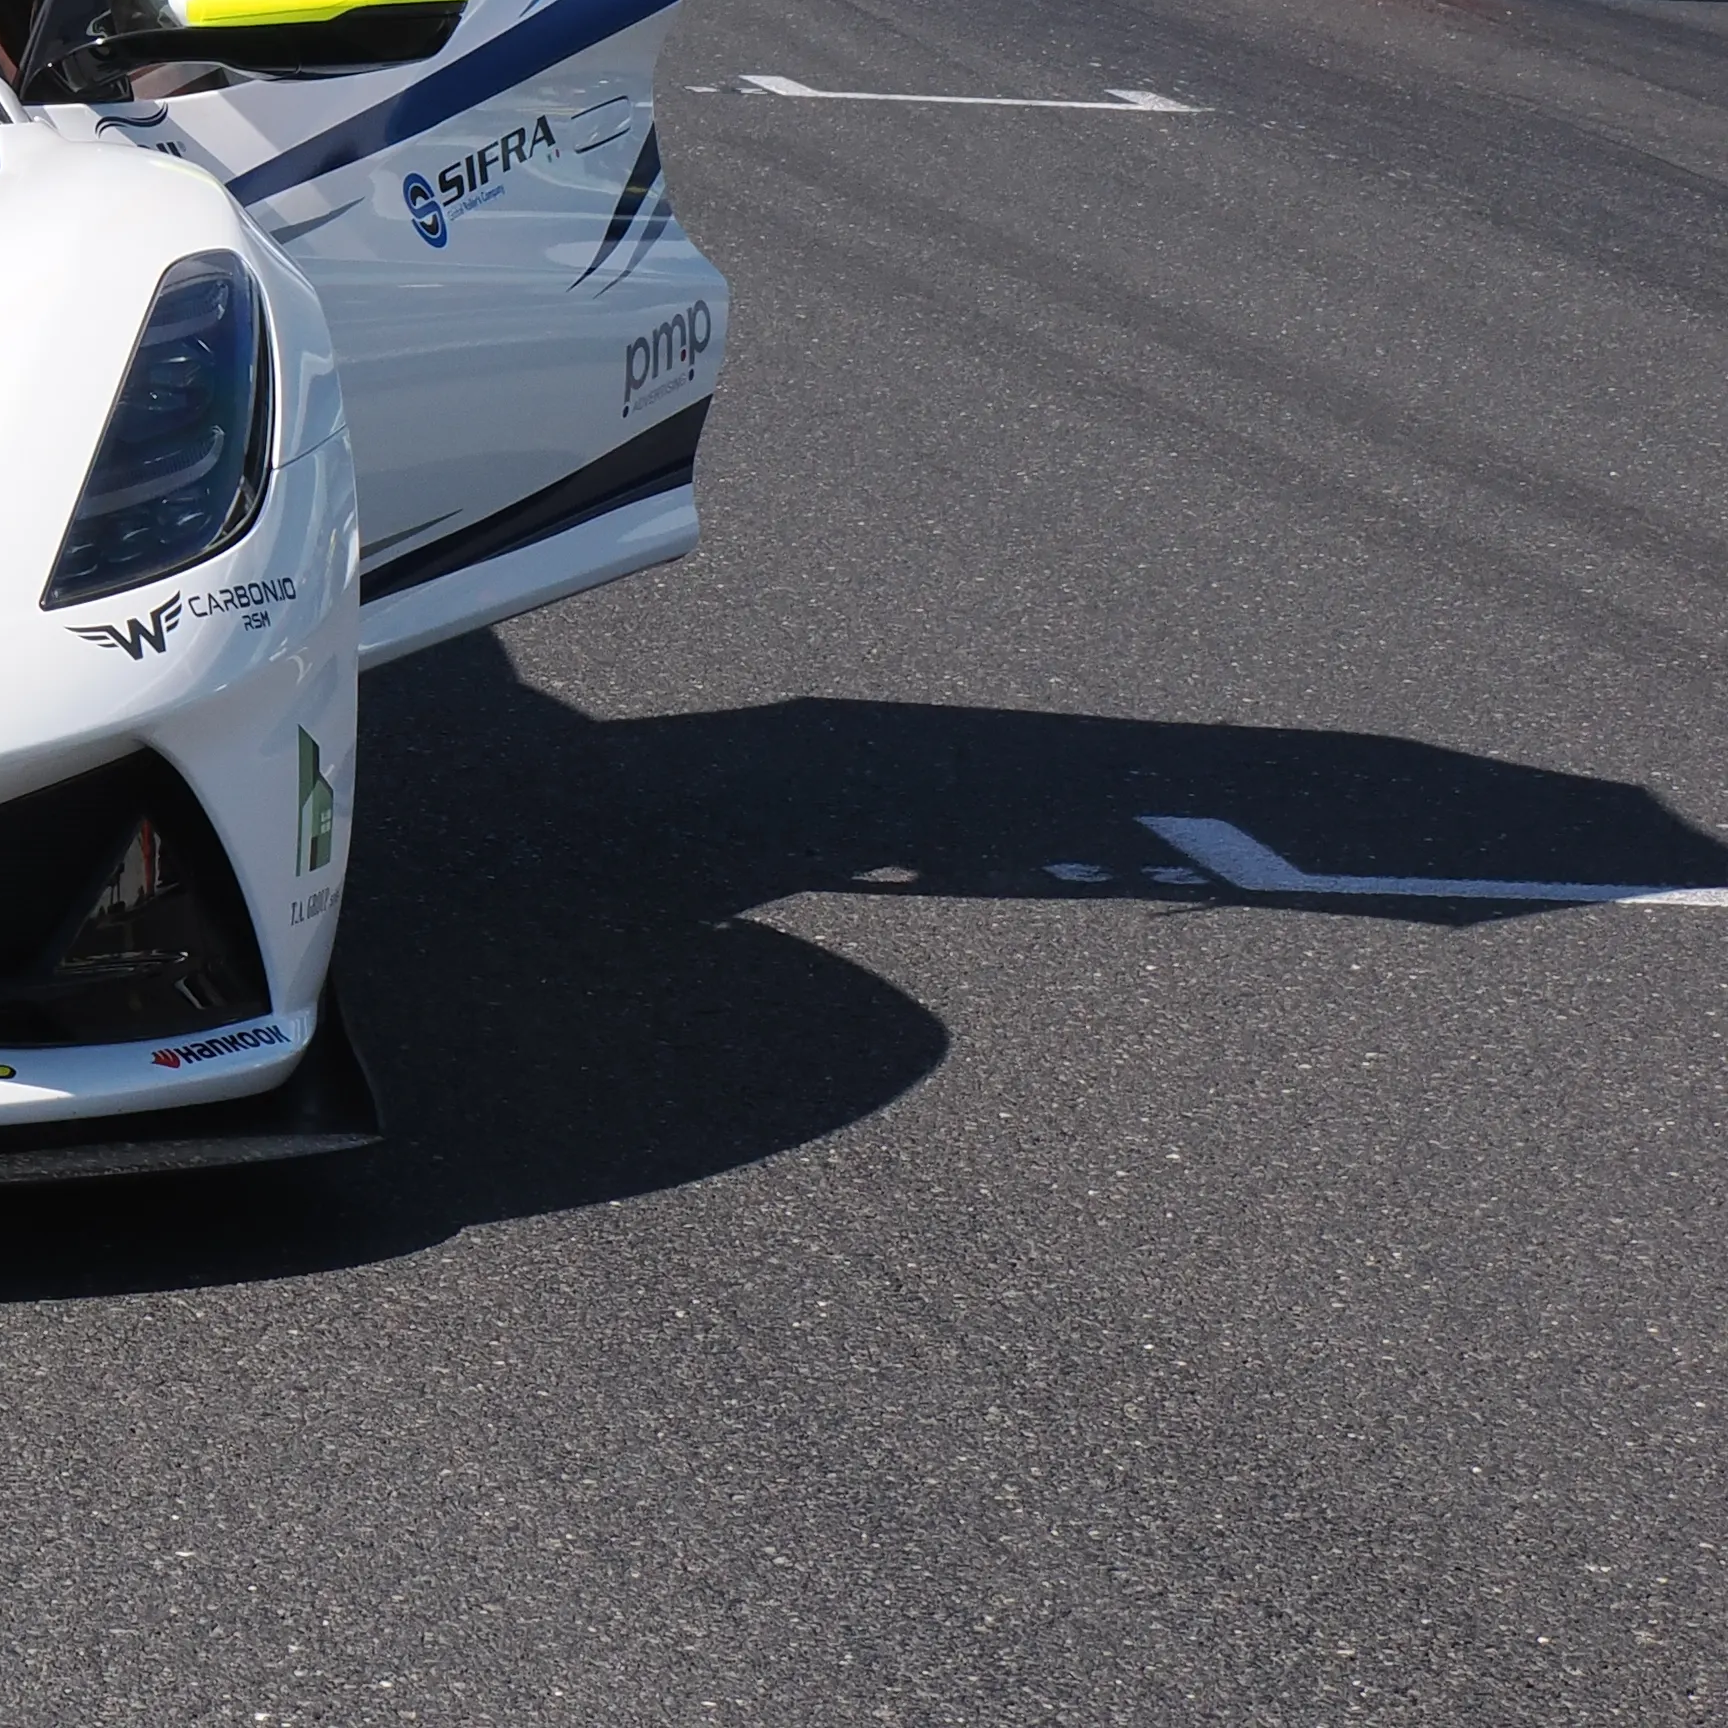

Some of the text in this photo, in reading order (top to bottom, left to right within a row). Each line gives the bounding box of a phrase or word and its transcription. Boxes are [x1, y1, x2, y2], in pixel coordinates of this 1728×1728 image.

[438, 114, 557, 207] SIFRA
[623, 299, 712, 412] pmp
[187, 577, 298, 619] CARBON.IO
[241, 610, 272, 632] RSM
